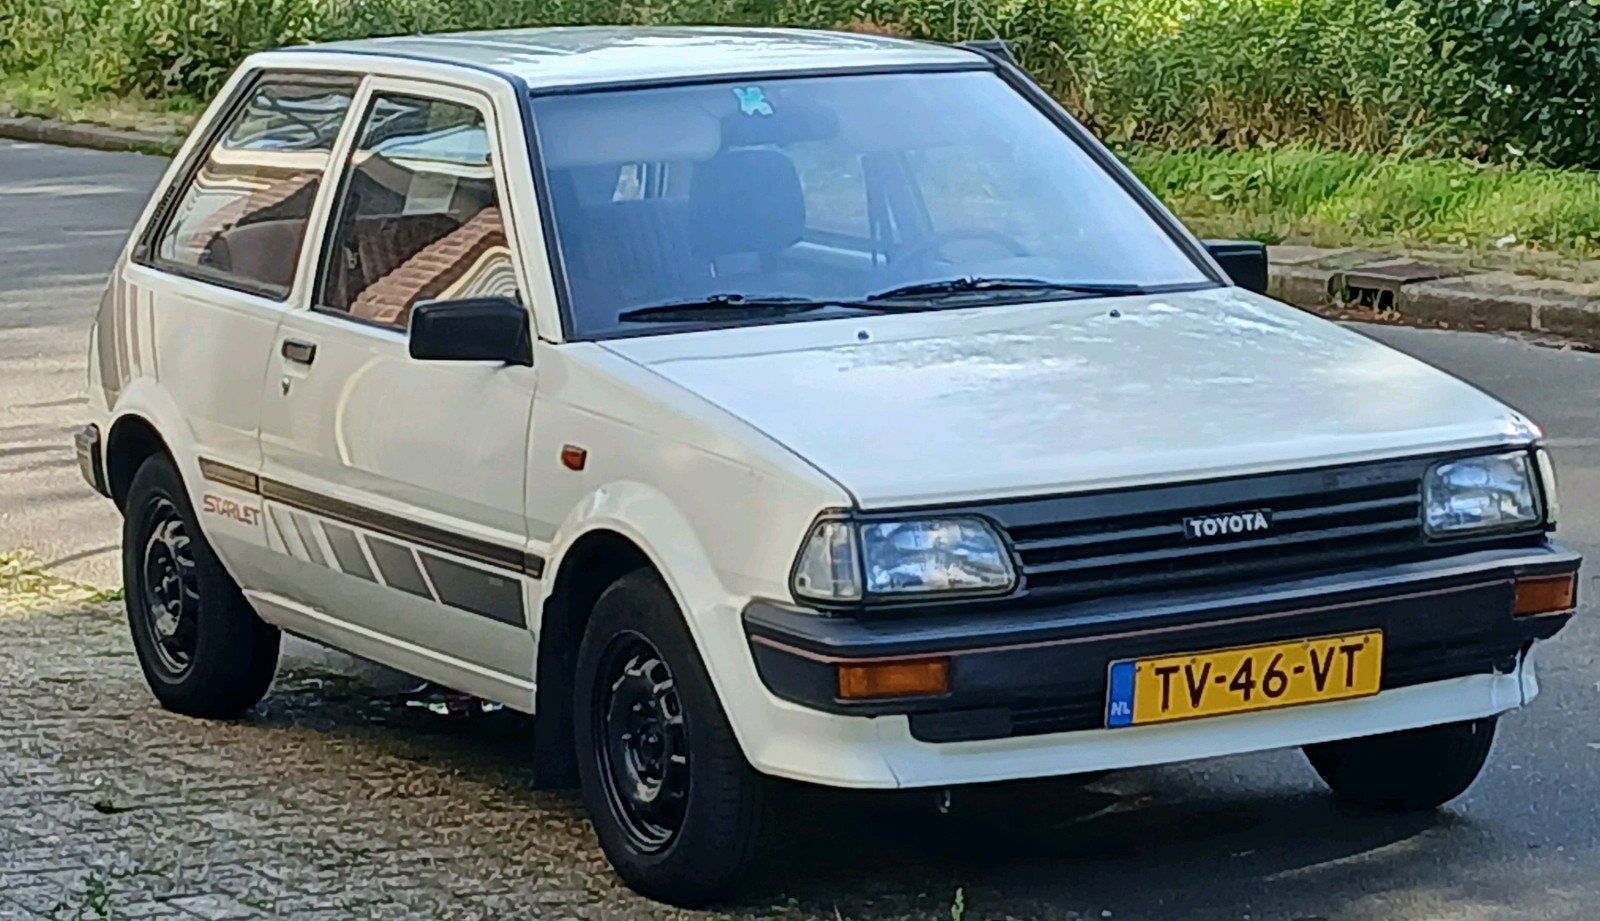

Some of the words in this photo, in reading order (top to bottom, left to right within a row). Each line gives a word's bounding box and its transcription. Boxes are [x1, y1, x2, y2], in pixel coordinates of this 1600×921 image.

[203, 494, 260, 526] STARLET
[1190, 512, 1268, 537] TOYOTA
[1155, 643, 1364, 712] TV-46-VT
[1111, 701, 1131, 716] NL
